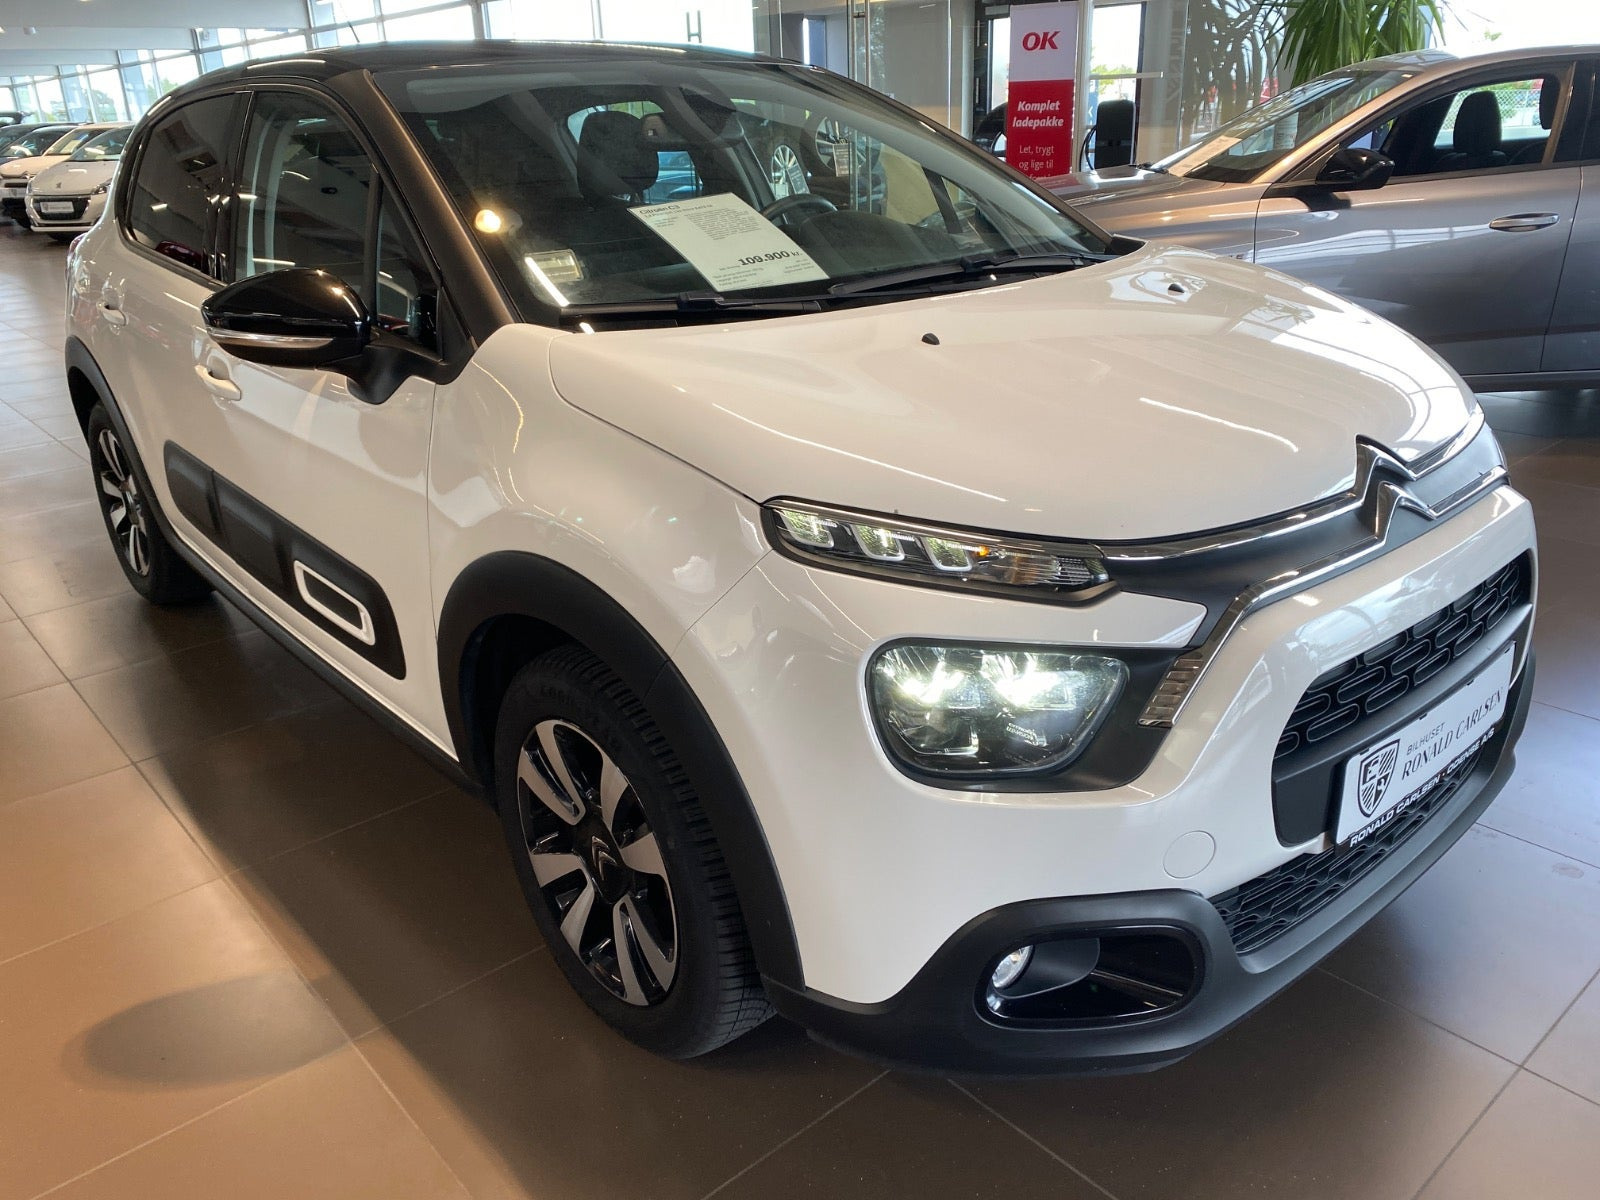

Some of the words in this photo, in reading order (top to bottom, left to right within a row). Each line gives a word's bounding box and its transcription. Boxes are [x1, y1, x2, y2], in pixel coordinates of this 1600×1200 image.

[1022, 30, 1061, 51] OK
[1017, 100, 1060, 114] Komplet
[1012, 116, 1064, 130] ladepakke
[1019, 145, 1033, 155] Let,
[1036, 145, 1054, 156] trygt
[1018, 162, 1029, 171] og
[1031, 159, 1044, 171] lige
[1046, 159, 1054, 168] til
[738, 250, 791, 266] 109.900
[1402, 730, 1453, 780] RONALD
[1456, 691, 1502, 740] CARLSEN
[1406, 722, 1445, 755] BILHUSET
[1349, 810, 1395, 847] RONALD
[1396, 774, 1441, 813] CARLSEN
